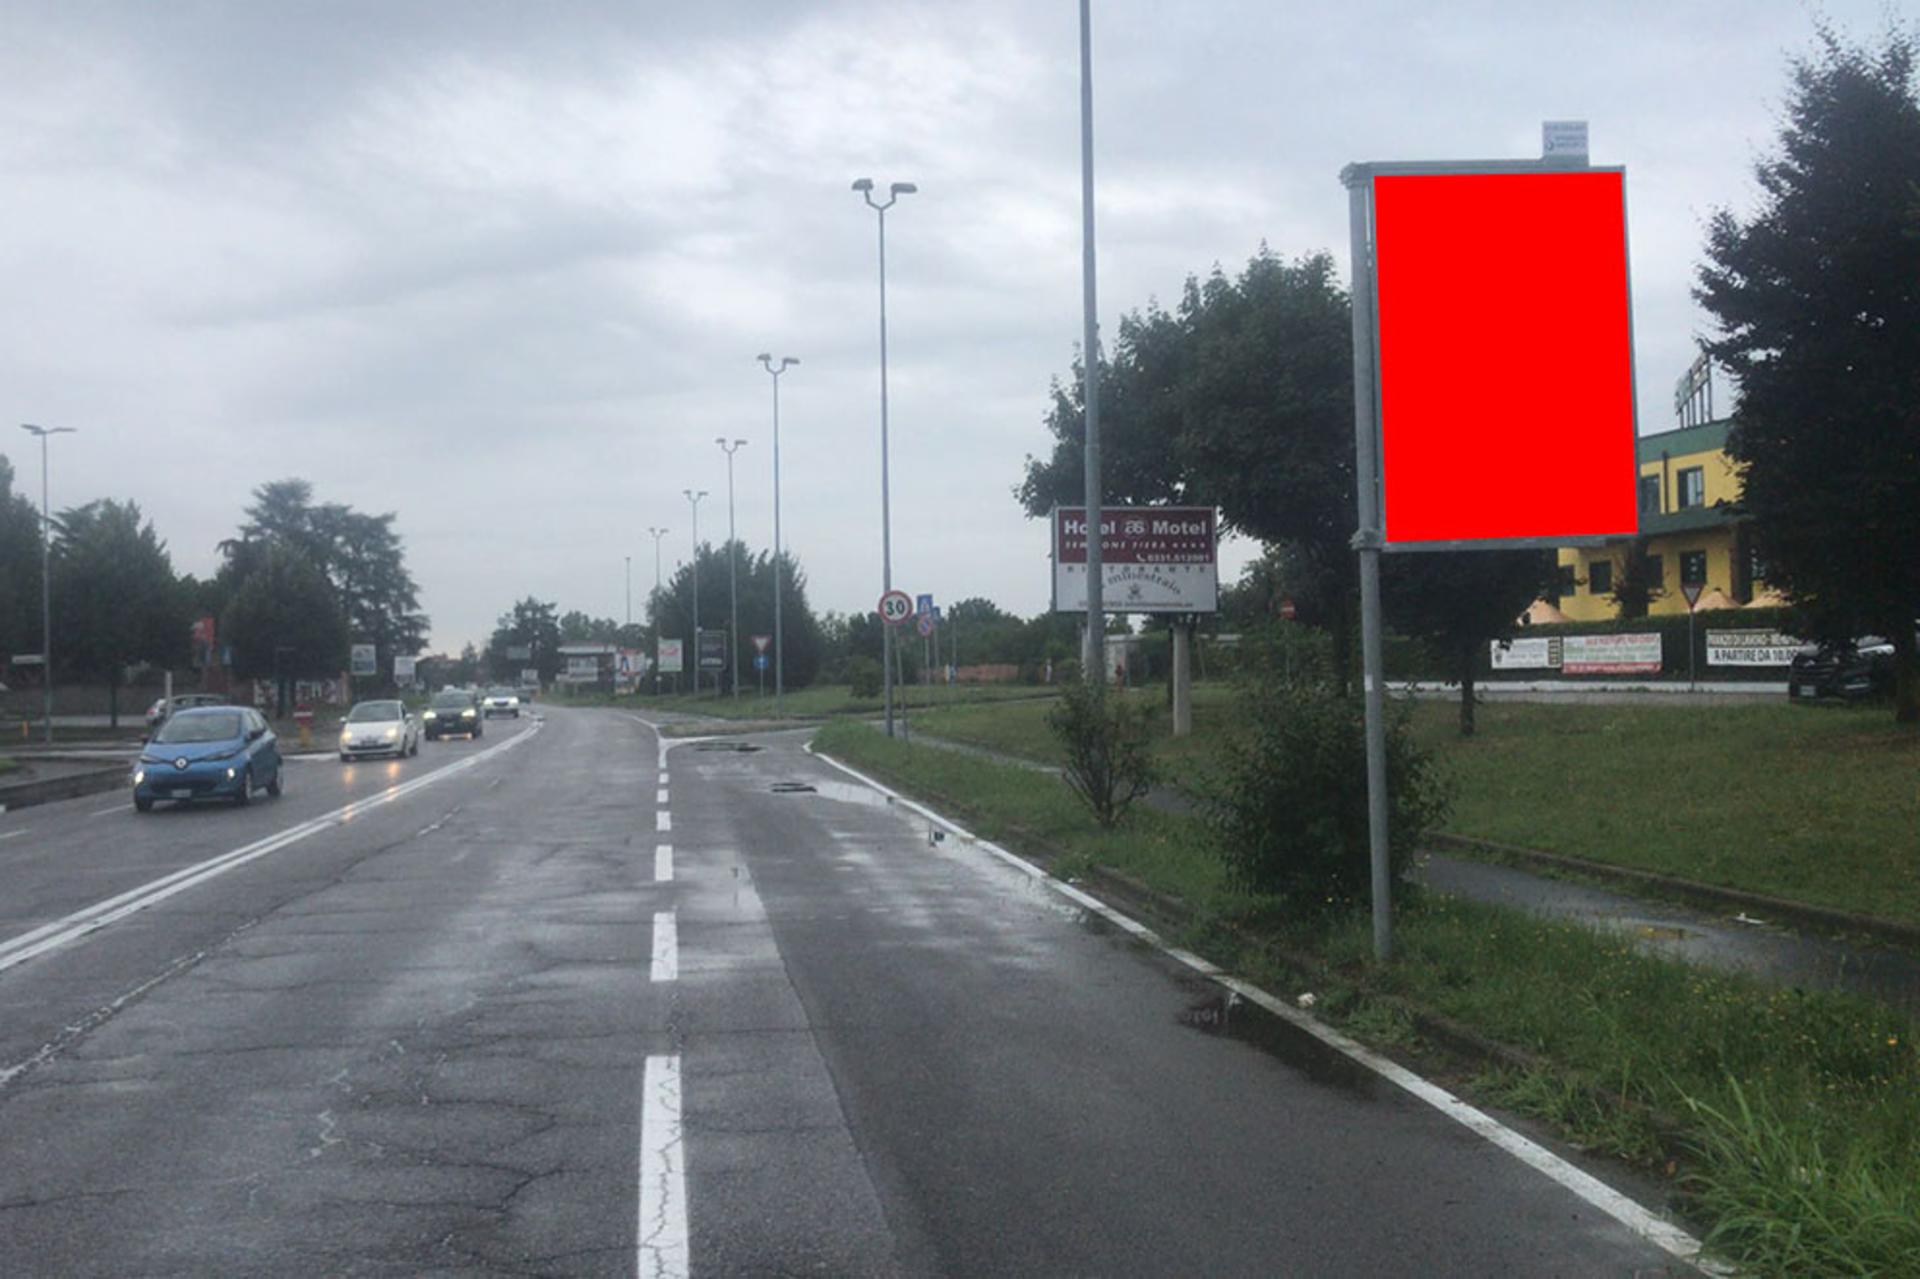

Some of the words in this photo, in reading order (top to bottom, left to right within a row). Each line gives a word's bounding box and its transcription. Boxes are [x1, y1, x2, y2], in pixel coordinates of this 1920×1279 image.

[1064, 520, 1116, 535] Hoel
[1152, 520, 1207, 535] Motel
[1065, 541, 1126, 550] SEMONE
[1067, 565, 1206, 573] RITORANTE
[886, 600, 905, 616] 30
[1722, 649, 1756, 661] PARTIRE
[1758, 649, 1772, 661] DA
